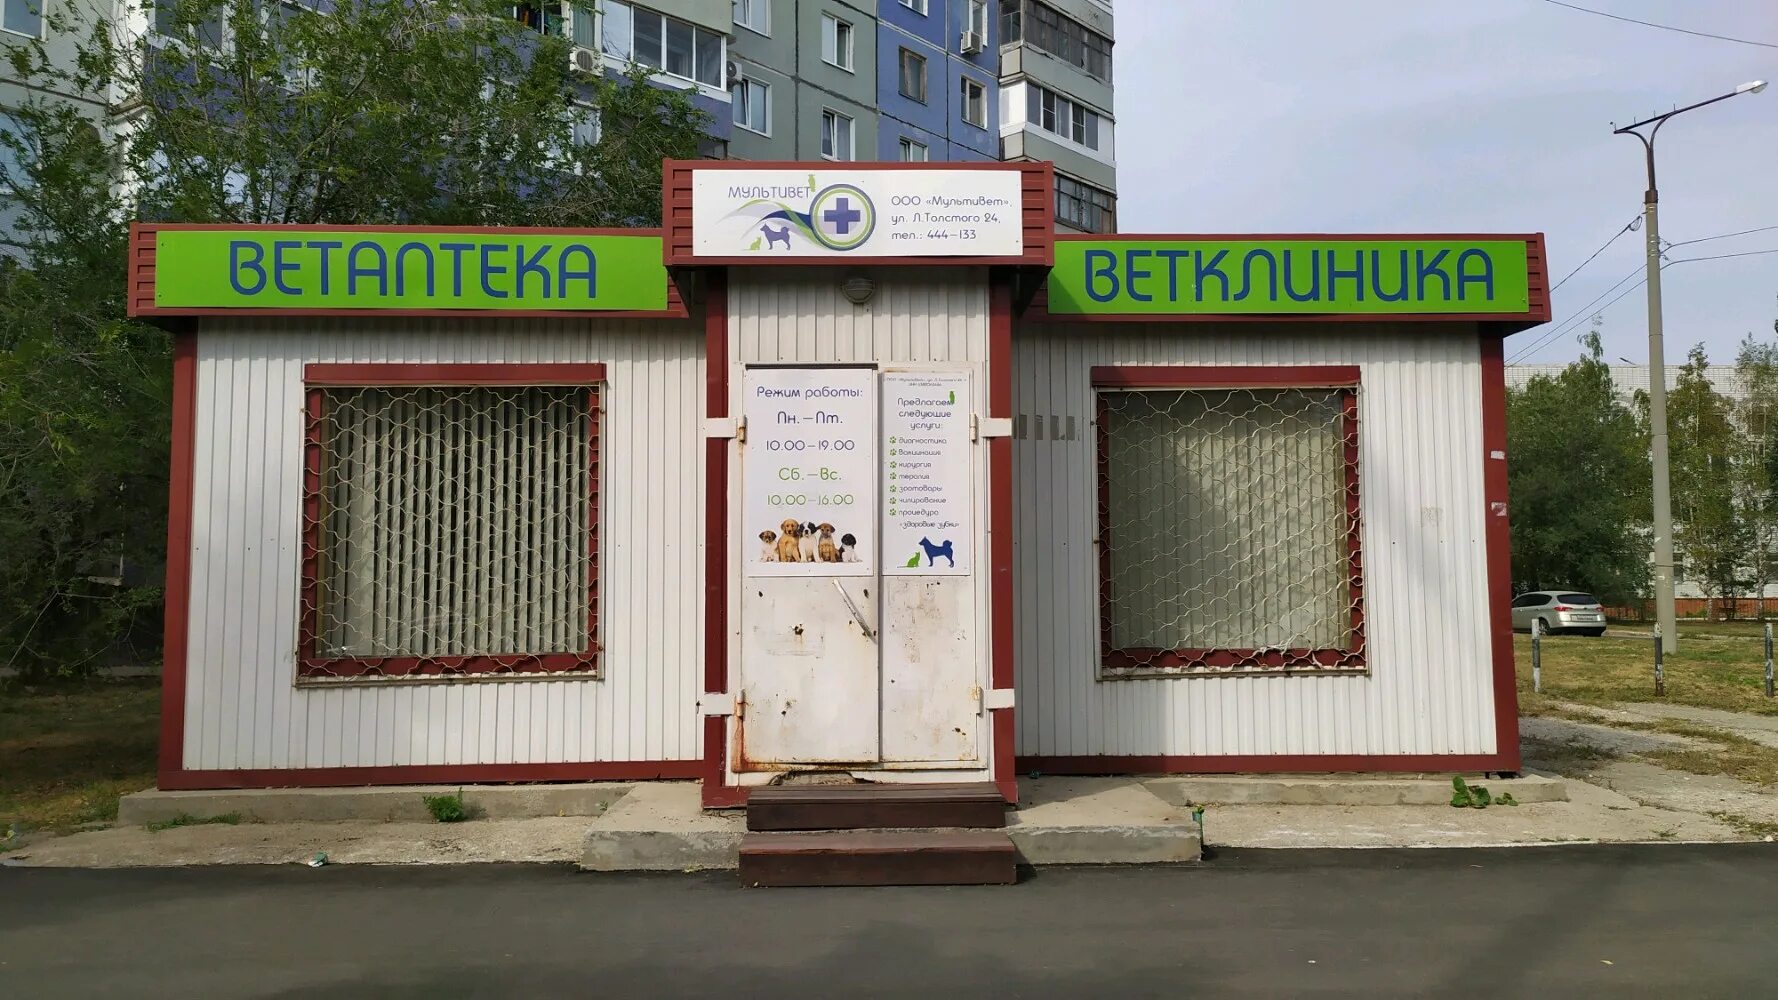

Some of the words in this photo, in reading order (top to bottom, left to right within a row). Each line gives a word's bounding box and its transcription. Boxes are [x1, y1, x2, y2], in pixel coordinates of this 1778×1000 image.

[727, 186, 811, 199] МУЛЬТИВЕТ
[891, 195, 921, 206] ООО
[891, 215, 908, 226] ул.
[983, 212, 1001, 224] 24,
[891, 231, 923, 240] тел.:
[228, 239, 598, 300] ВЕТАПТЕКА
[1084, 248, 1494, 303] ВЕТКЛИНИКА
[756, 386, 801, 398] Режим
[805, 386, 863, 401] работы:
[898, 436, 947, 445] диагностика
